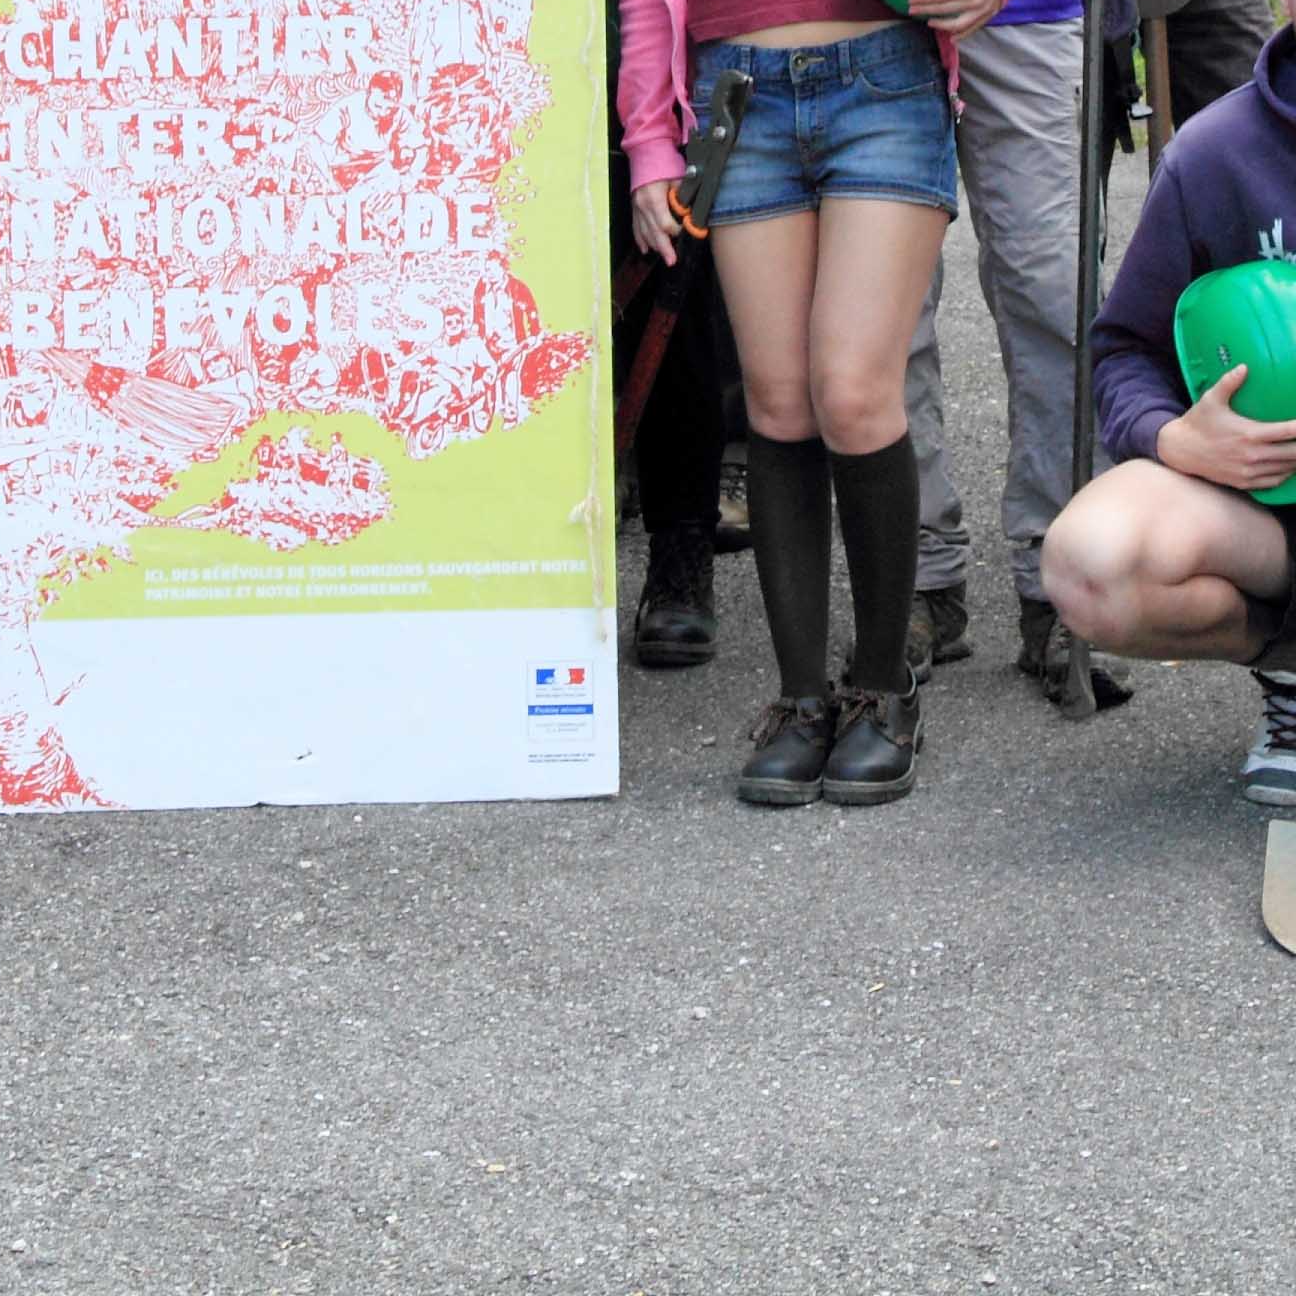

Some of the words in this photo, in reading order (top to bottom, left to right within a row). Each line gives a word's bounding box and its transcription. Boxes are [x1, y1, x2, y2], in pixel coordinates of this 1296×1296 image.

[5, 15, 374, 82] CHANTIER
[11, 196, 378, 260] NATIONAL
[405, 198, 490, 253] DE
[12, 278, 444, 350] BENEVOLES
